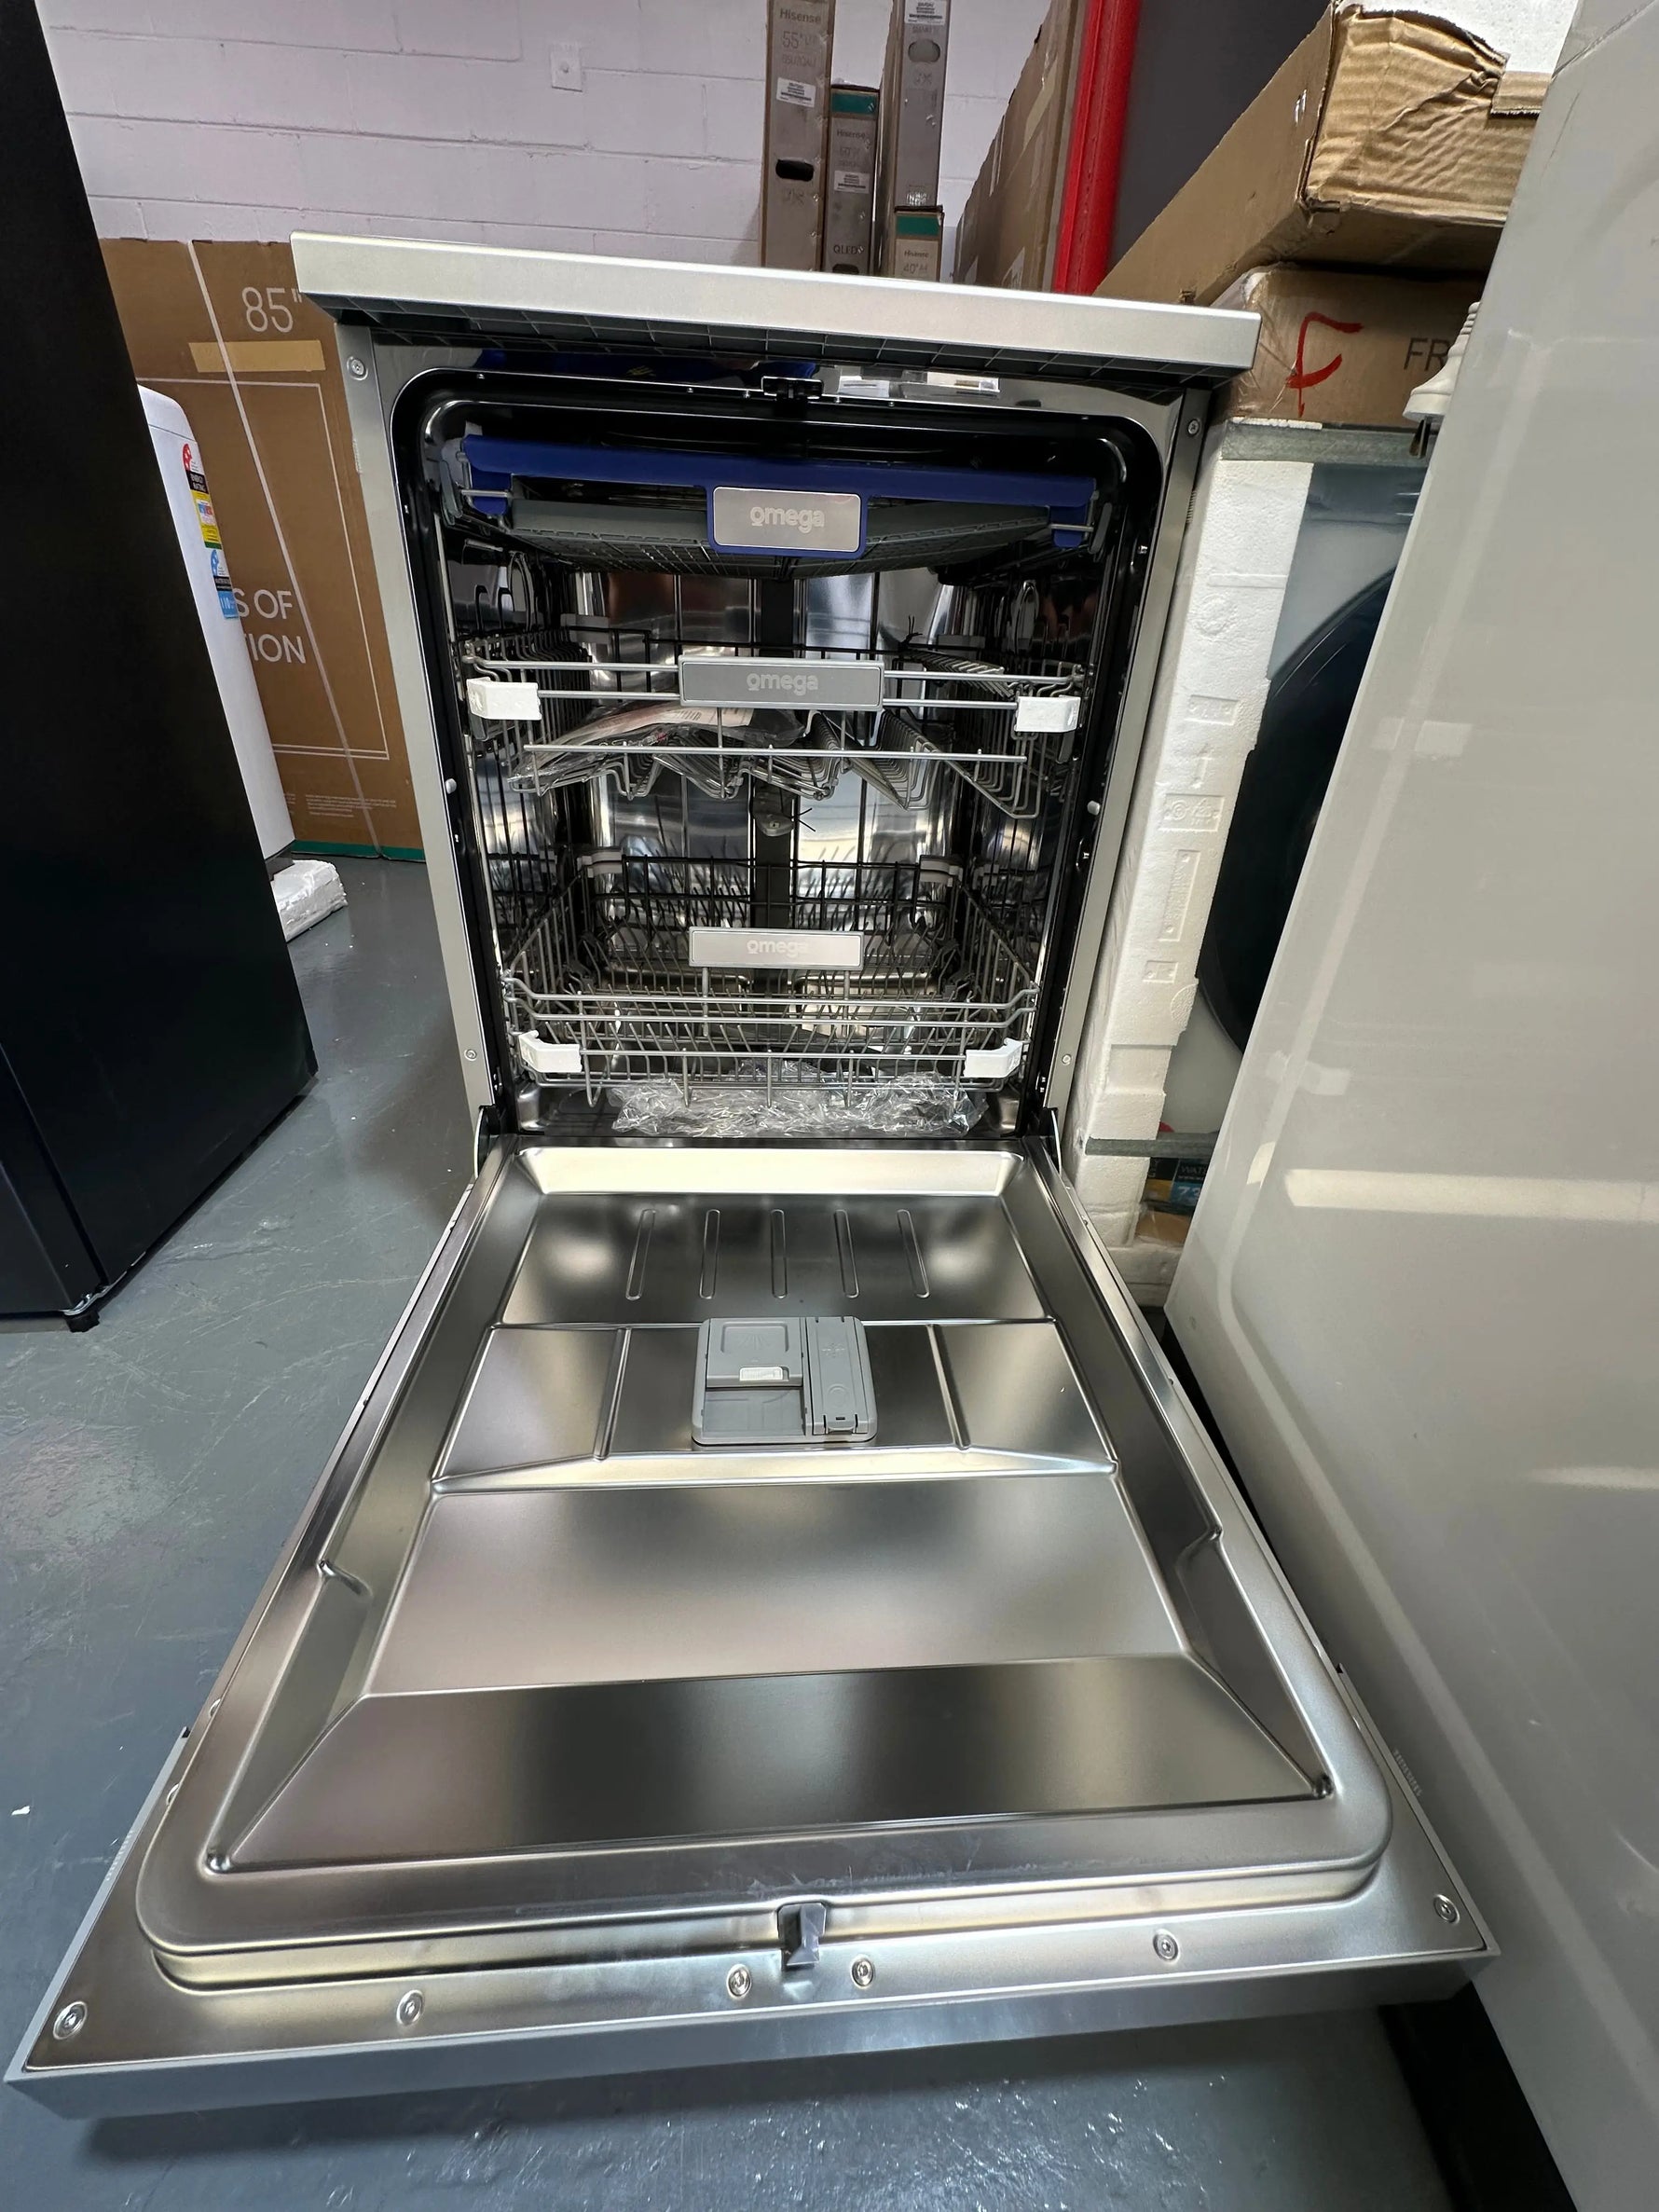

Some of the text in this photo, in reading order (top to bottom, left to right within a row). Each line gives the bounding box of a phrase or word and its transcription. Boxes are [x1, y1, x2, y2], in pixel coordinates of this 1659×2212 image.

[780, 7, 821, 23] Hisense
[241, 286, 303, 333] 85"
[749, 506, 825, 534] omega
[253, 589, 294, 620] OF
[243, 633, 306, 664] ION
[746, 673, 818, 696] omega
